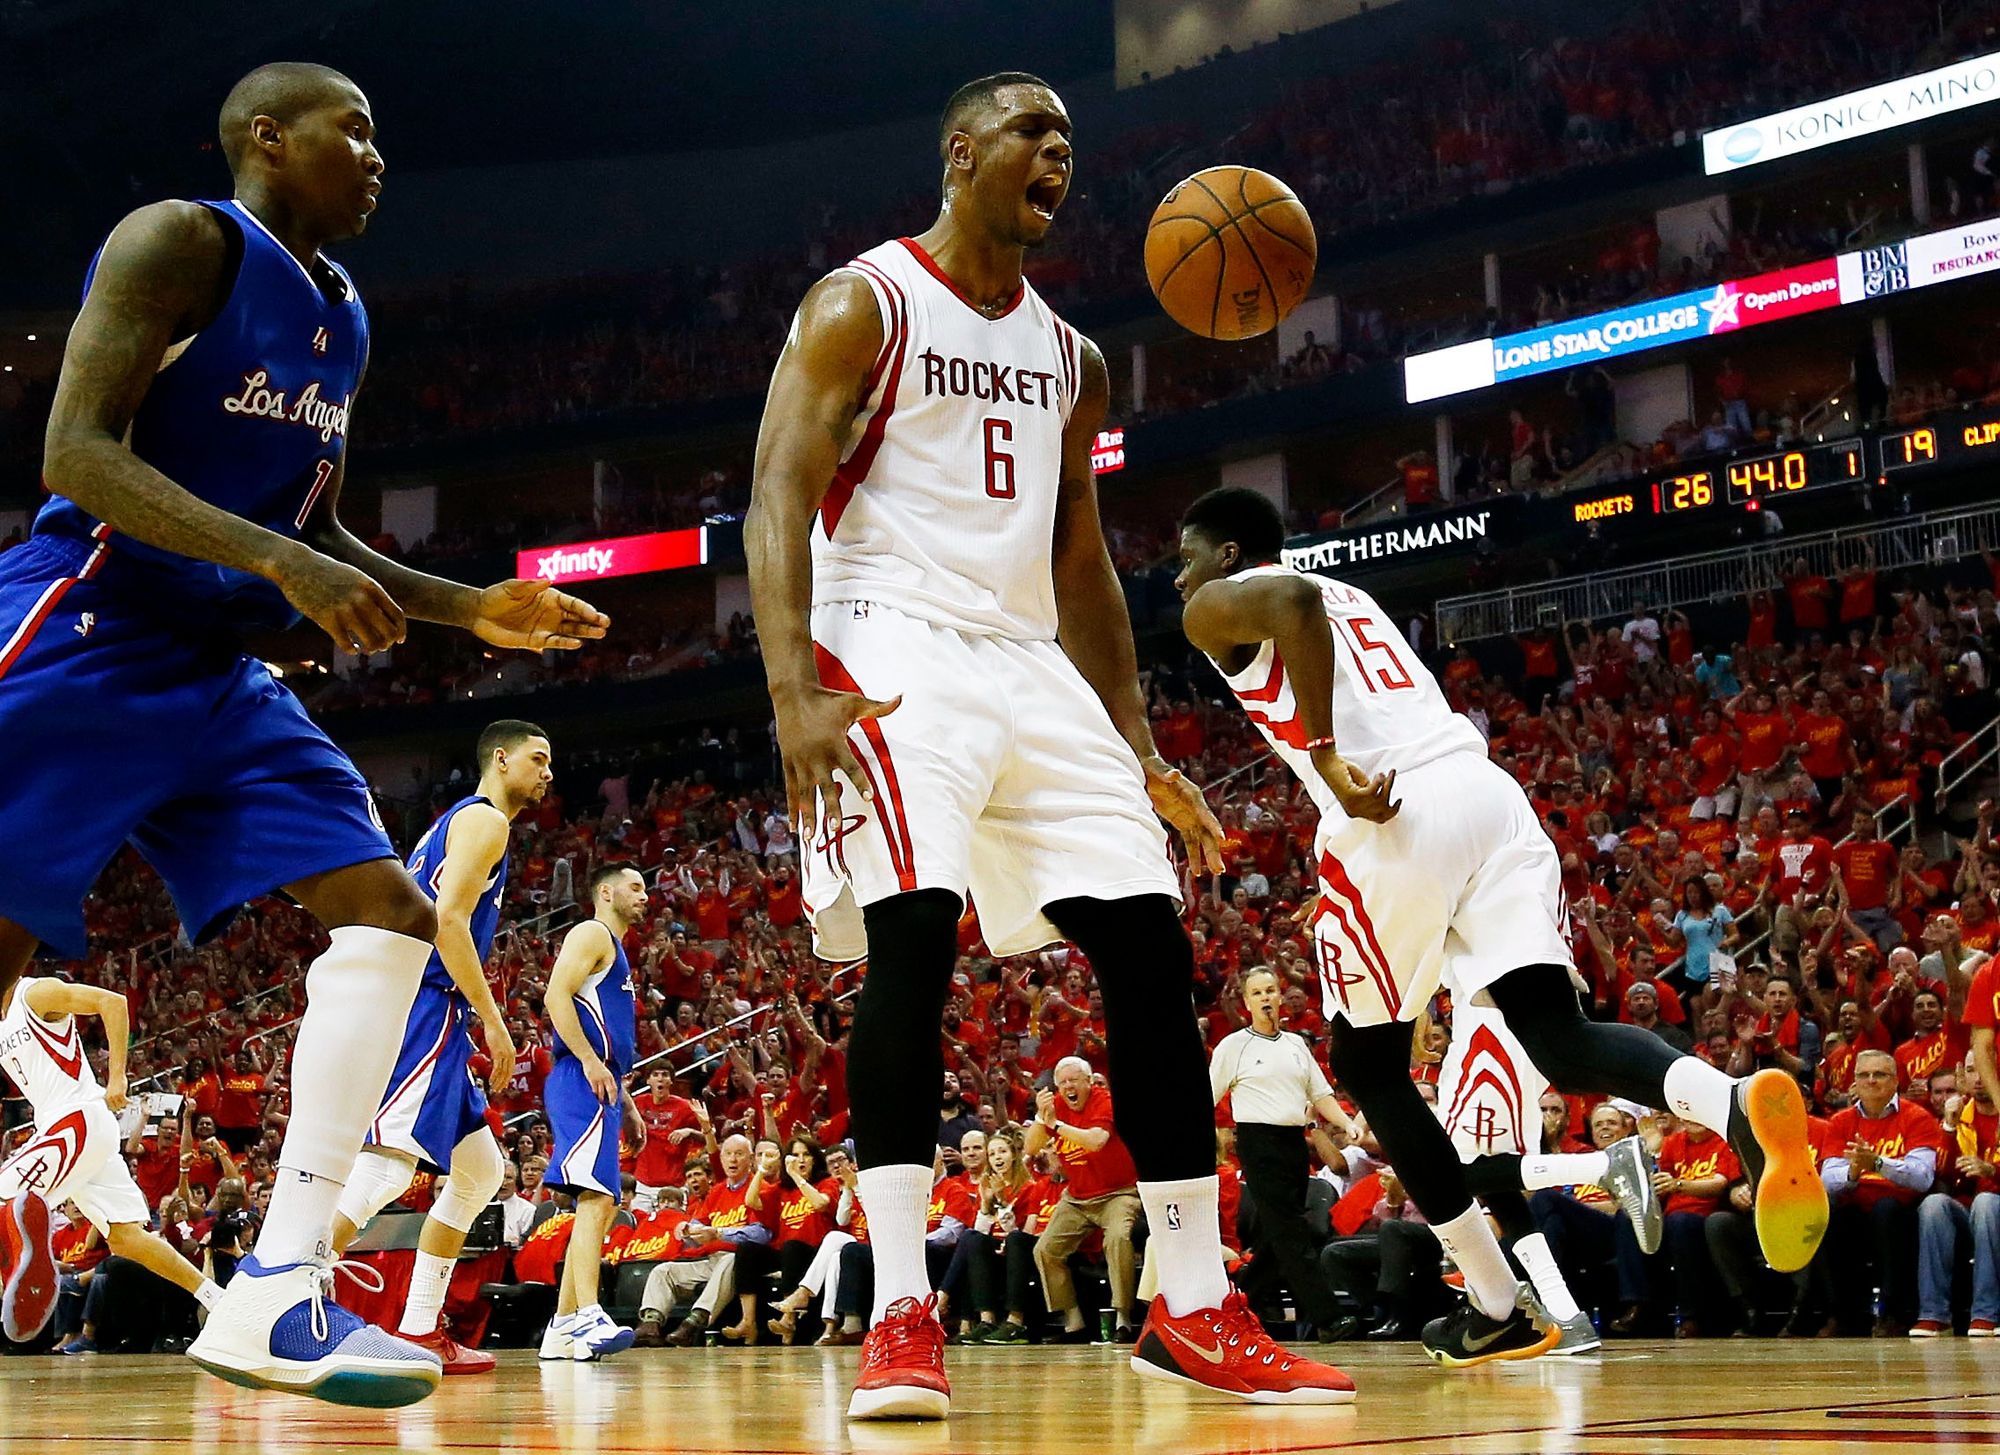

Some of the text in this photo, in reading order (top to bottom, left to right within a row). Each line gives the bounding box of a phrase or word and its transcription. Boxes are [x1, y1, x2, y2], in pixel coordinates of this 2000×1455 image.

[1777, 68, 1996, 145] KONICA MINO
[1744, 277, 1837, 310] Open Doors
[1494, 305, 1699, 372] LONE STAR COLLEGE
[223, 370, 286, 420] Los
[983, 418, 1016, 500] 6
[1903, 422, 2000, 464] 19 CLIP
[294, 459, 334, 530] 1
[1575, 473, 1711, 522] ROCKETS 26
[1730, 452, 1806, 496] 44.0
[537, 546, 613, 580] xfinity
[1348, 513, 1487, 563] HERMANN
[1328, 617, 1416, 694] 15
[623, 1231, 671, 1260] Clutch
